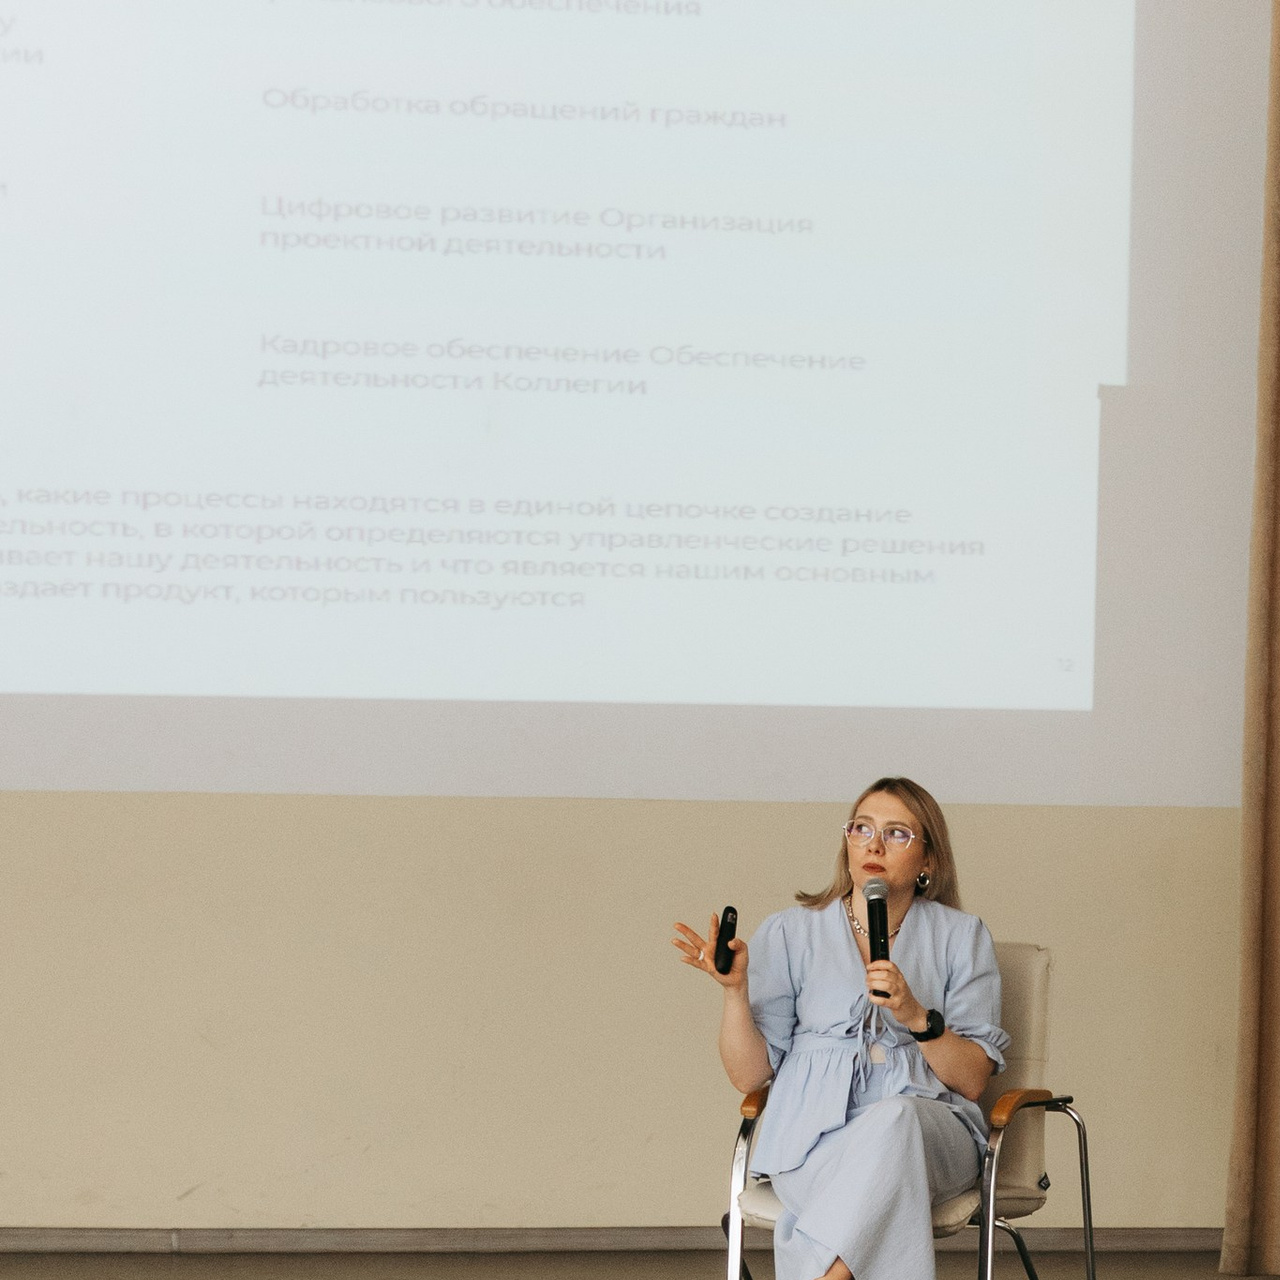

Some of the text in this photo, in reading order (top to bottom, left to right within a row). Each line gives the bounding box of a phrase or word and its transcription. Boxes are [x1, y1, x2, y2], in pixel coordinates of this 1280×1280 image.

[262, 87, 787, 130] Обработка обращений граждан
[261, 196, 814, 235] Цифровое развитие Организация
[259, 231, 667, 260] проектной деятельности
[260, 334, 867, 371] Кадровое обеспечение Обеспечение
[256, 369, 648, 396] деятельности Коллегии
[16, 488, 913, 524] какие процессы находятся в единой цепочке создание
[154, 522, 173, 538] в
[182, 520, 316, 544] которой
[325, 526, 561, 546] определяются
[569, 532, 832, 552] управленческие
[841, 537, 986, 557] решения
[86, 551, 173, 574] нашу
[179, 553, 403, 573] деятельность
[411, 559, 431, 573] и
[440, 559, 494, 575] что
[501, 560, 646, 578] является
[655, 563, 765, 581] нашим
[773, 566, 935, 584] основным
[100, 582, 241, 606] продукт,
[249, 585, 391, 608] которым
[399, 588, 586, 612] пользуются
